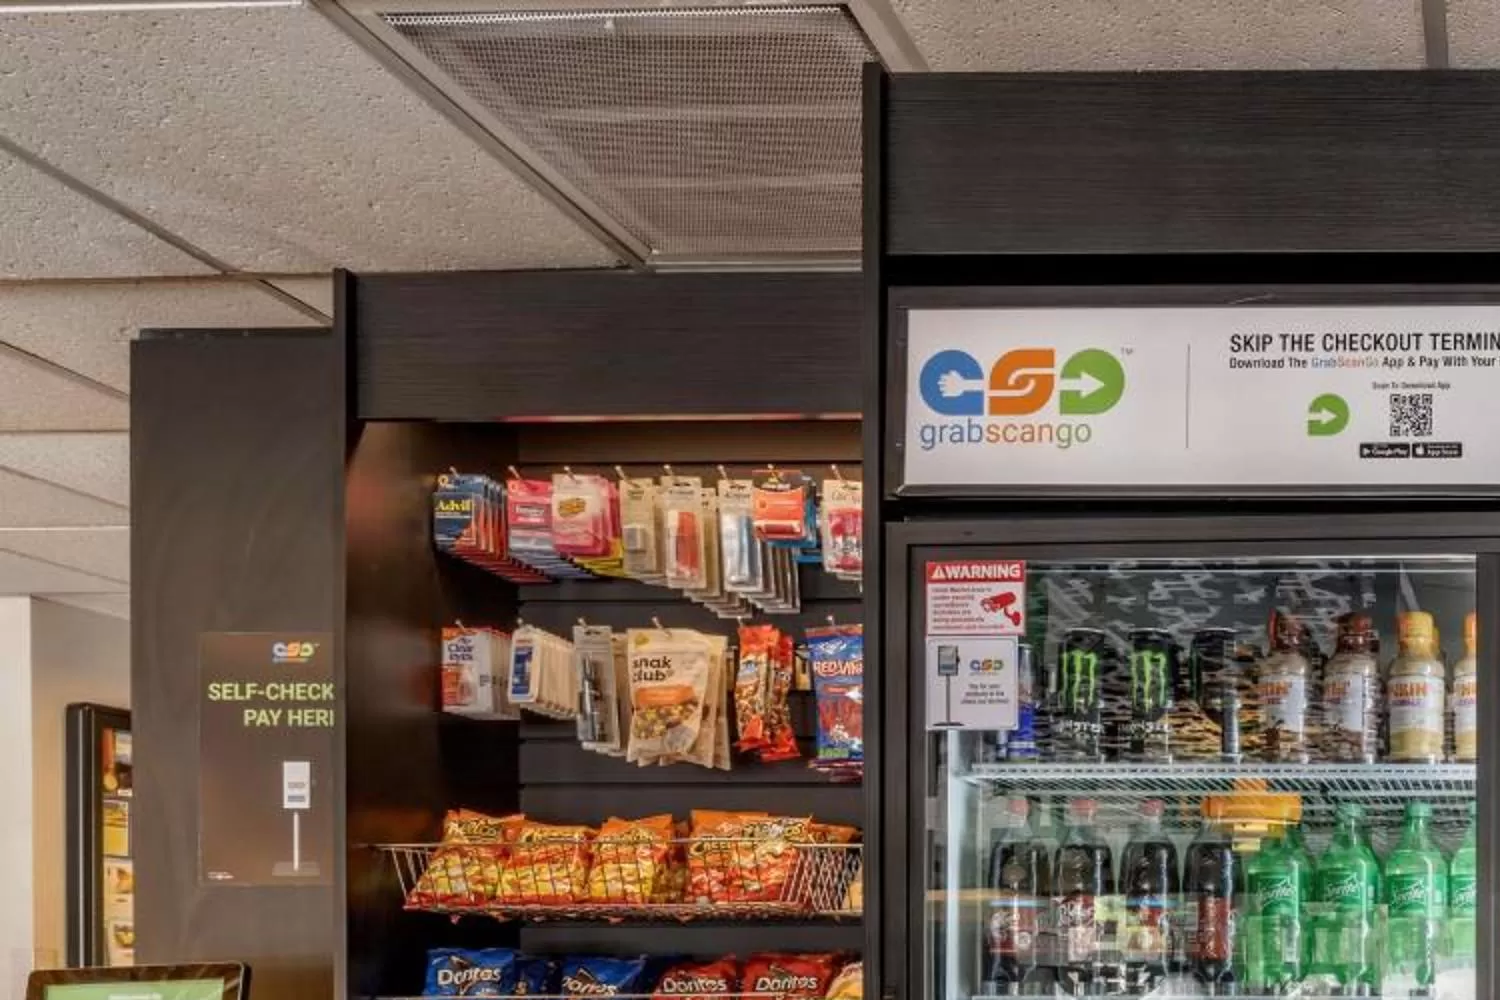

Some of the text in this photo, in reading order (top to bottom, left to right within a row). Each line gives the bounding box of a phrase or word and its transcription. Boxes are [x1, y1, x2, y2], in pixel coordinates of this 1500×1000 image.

[1230, 333, 1273, 352] SKIP
[1279, 333, 1315, 352] THE
[1322, 333, 1423, 352] CHECKOUT
[1229, 357, 1285, 369] Download
[1287, 357, 1308, 369] The
[1382, 356, 1404, 370] App
[1407, 357, 1416, 368] &
[1418, 355, 1440, 369] Pay
[1442, 355, 1468, 368] With
[1471, 355, 1496, 368] Your
[919, 419, 1092, 451] grabscango
[435, 499, 472, 512] Advil
[946, 563, 1021, 579] WARNING
[632, 655, 672, 669] snak
[208, 682, 335, 701] SELF-CHECK
[243, 708, 283, 727] PAY
[437, 967, 501, 986] Doritos
[756, 976, 818, 992] Doritos
[663, 977, 728, 993] Doritos
